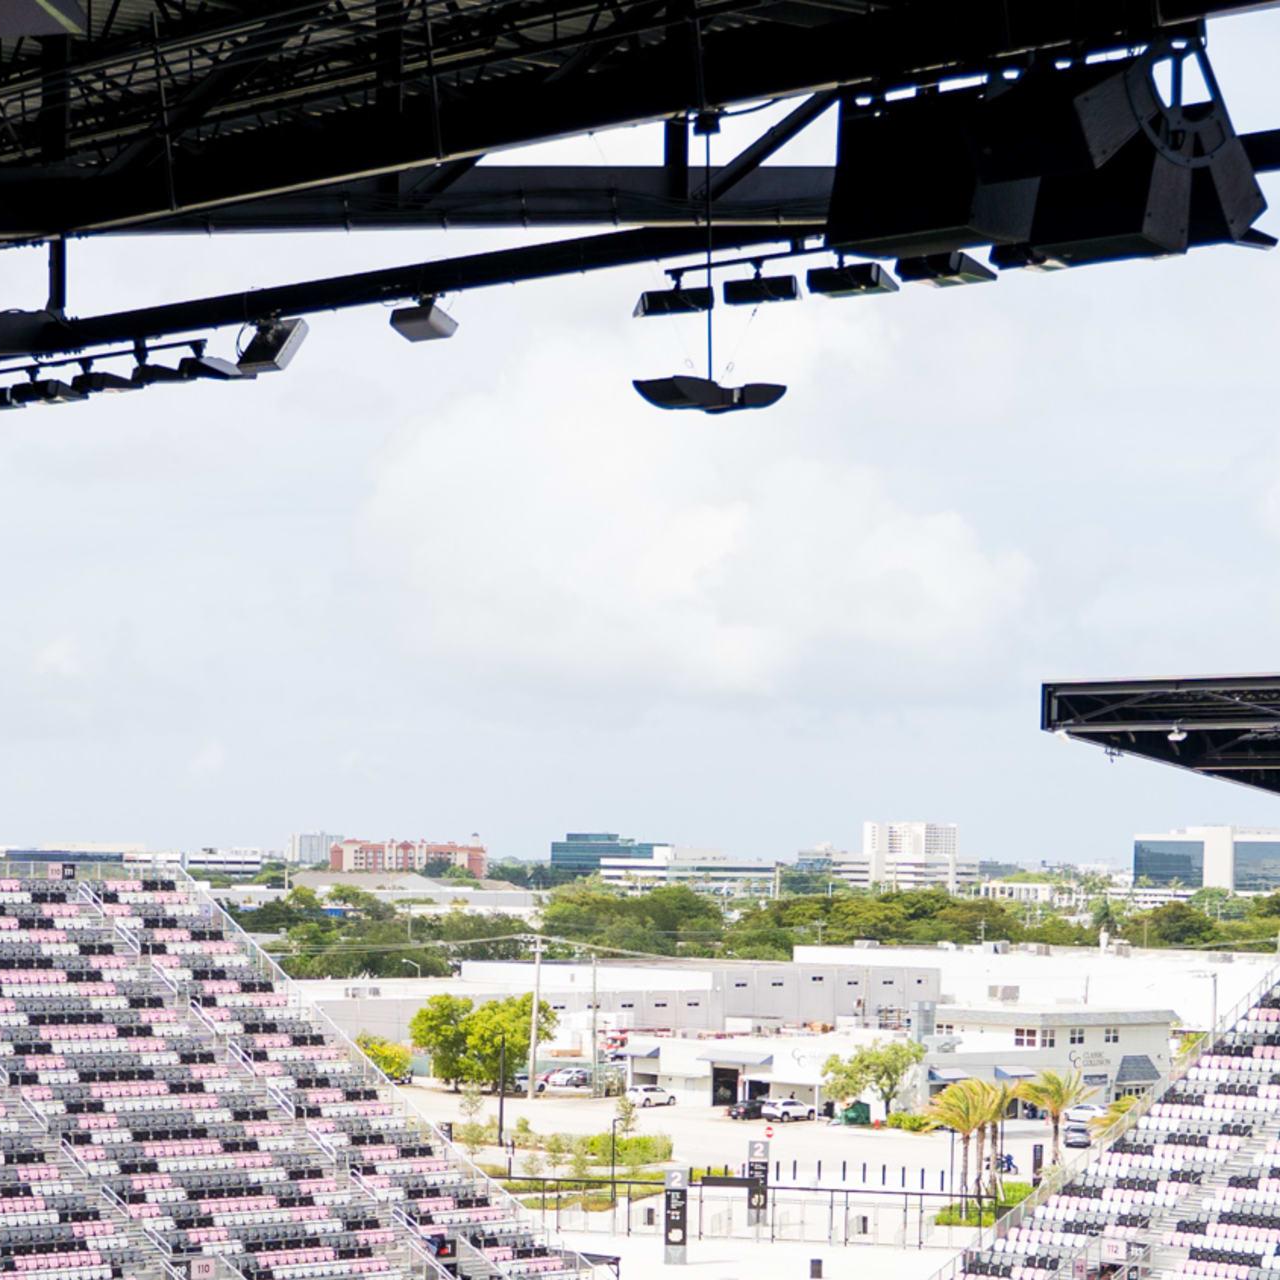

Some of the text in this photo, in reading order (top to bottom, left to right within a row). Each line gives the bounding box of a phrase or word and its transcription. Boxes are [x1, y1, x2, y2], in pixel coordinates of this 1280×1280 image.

[754, 1143, 765, 1158] 2
[671, 1172, 682, 1188] 2
[198, 1264, 210, 1274] 110
